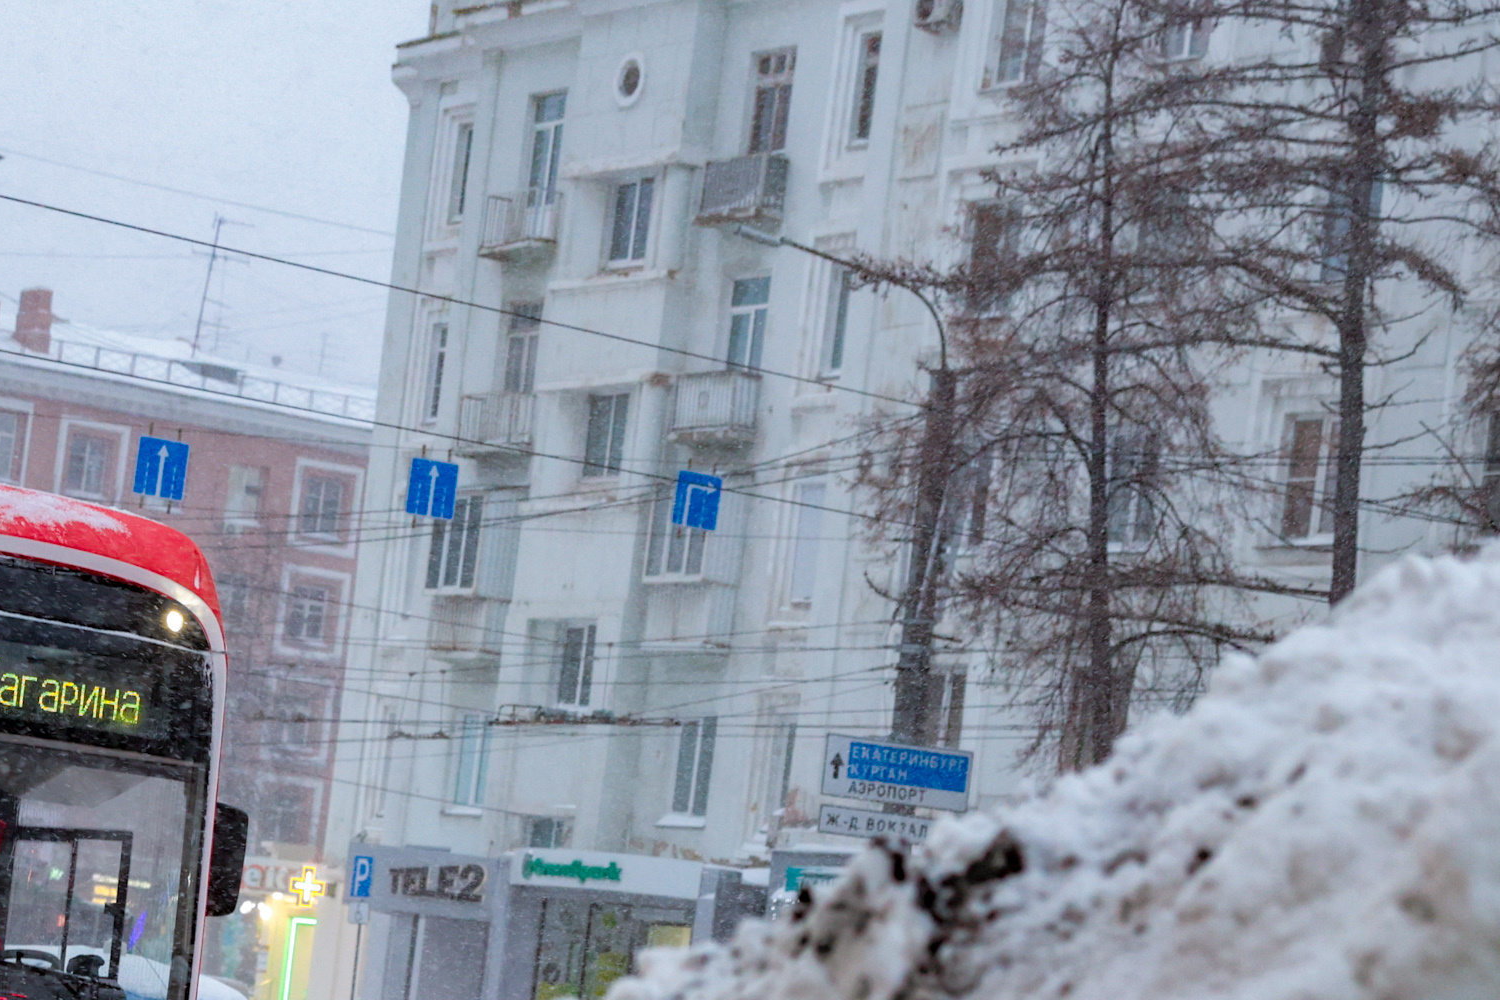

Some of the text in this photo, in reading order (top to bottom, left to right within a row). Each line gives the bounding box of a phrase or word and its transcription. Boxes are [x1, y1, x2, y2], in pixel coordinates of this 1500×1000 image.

[852, 746, 965, 772] ЕКАТЕРИНБУРГ
[848, 780, 926, 803] АЭРОПОРТ
[866, 817, 930, 839] ВОКЗАЛ
[389, 864, 486, 903] TELE2
